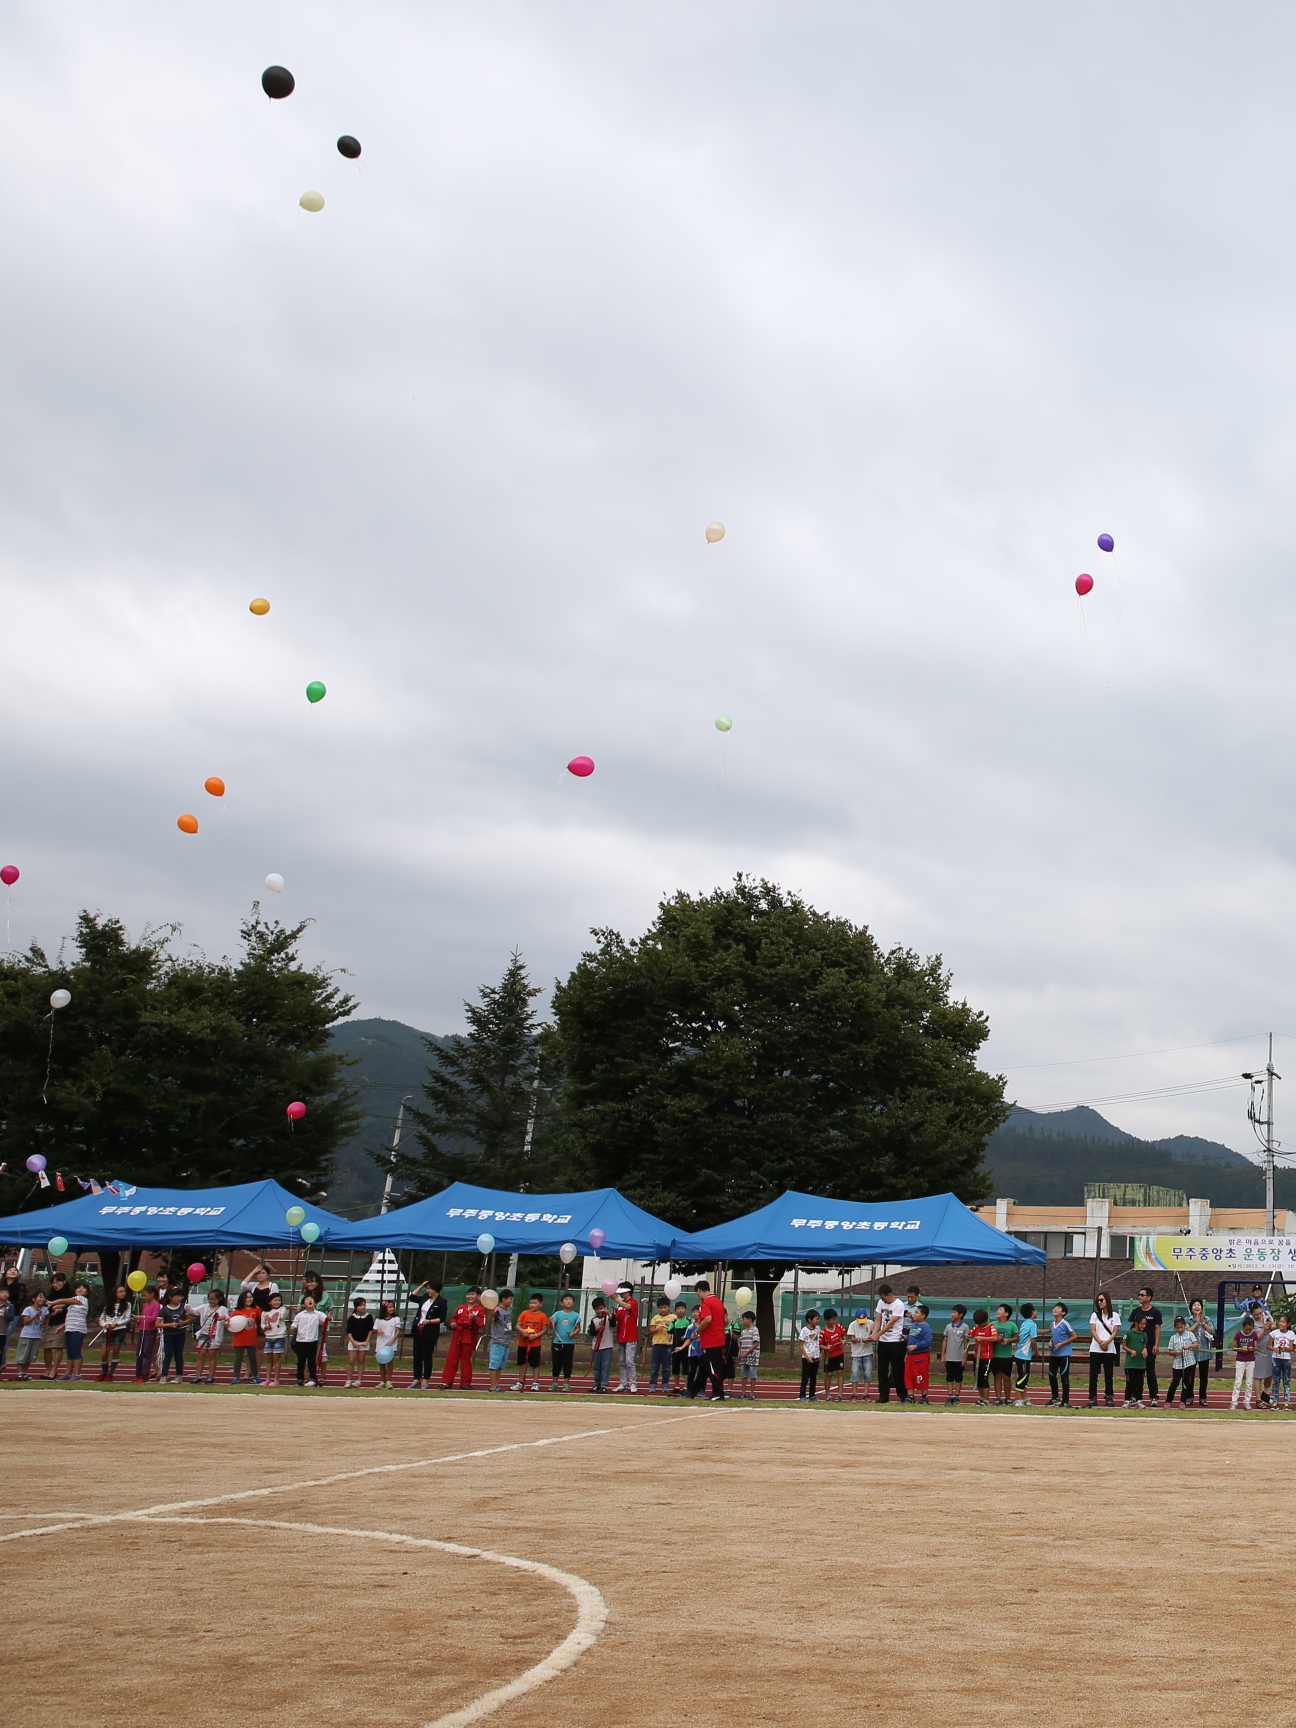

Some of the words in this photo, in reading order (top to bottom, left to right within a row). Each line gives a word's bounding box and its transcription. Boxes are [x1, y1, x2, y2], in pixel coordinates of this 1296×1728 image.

[446, 1208, 572, 1223] 무주중앙초등학교
[790, 1218, 921, 1230] 무주중앙초등학교
[1228, 1238, 1243, 1246] 밝은
[1245, 1238, 1275, 1246] 마음으로
[1277, 1238, 1292, 1246] 꿈을
[1171, 1247, 1237, 1261] 무주중앙초
[1242, 1247, 1282, 1262] 운동장
